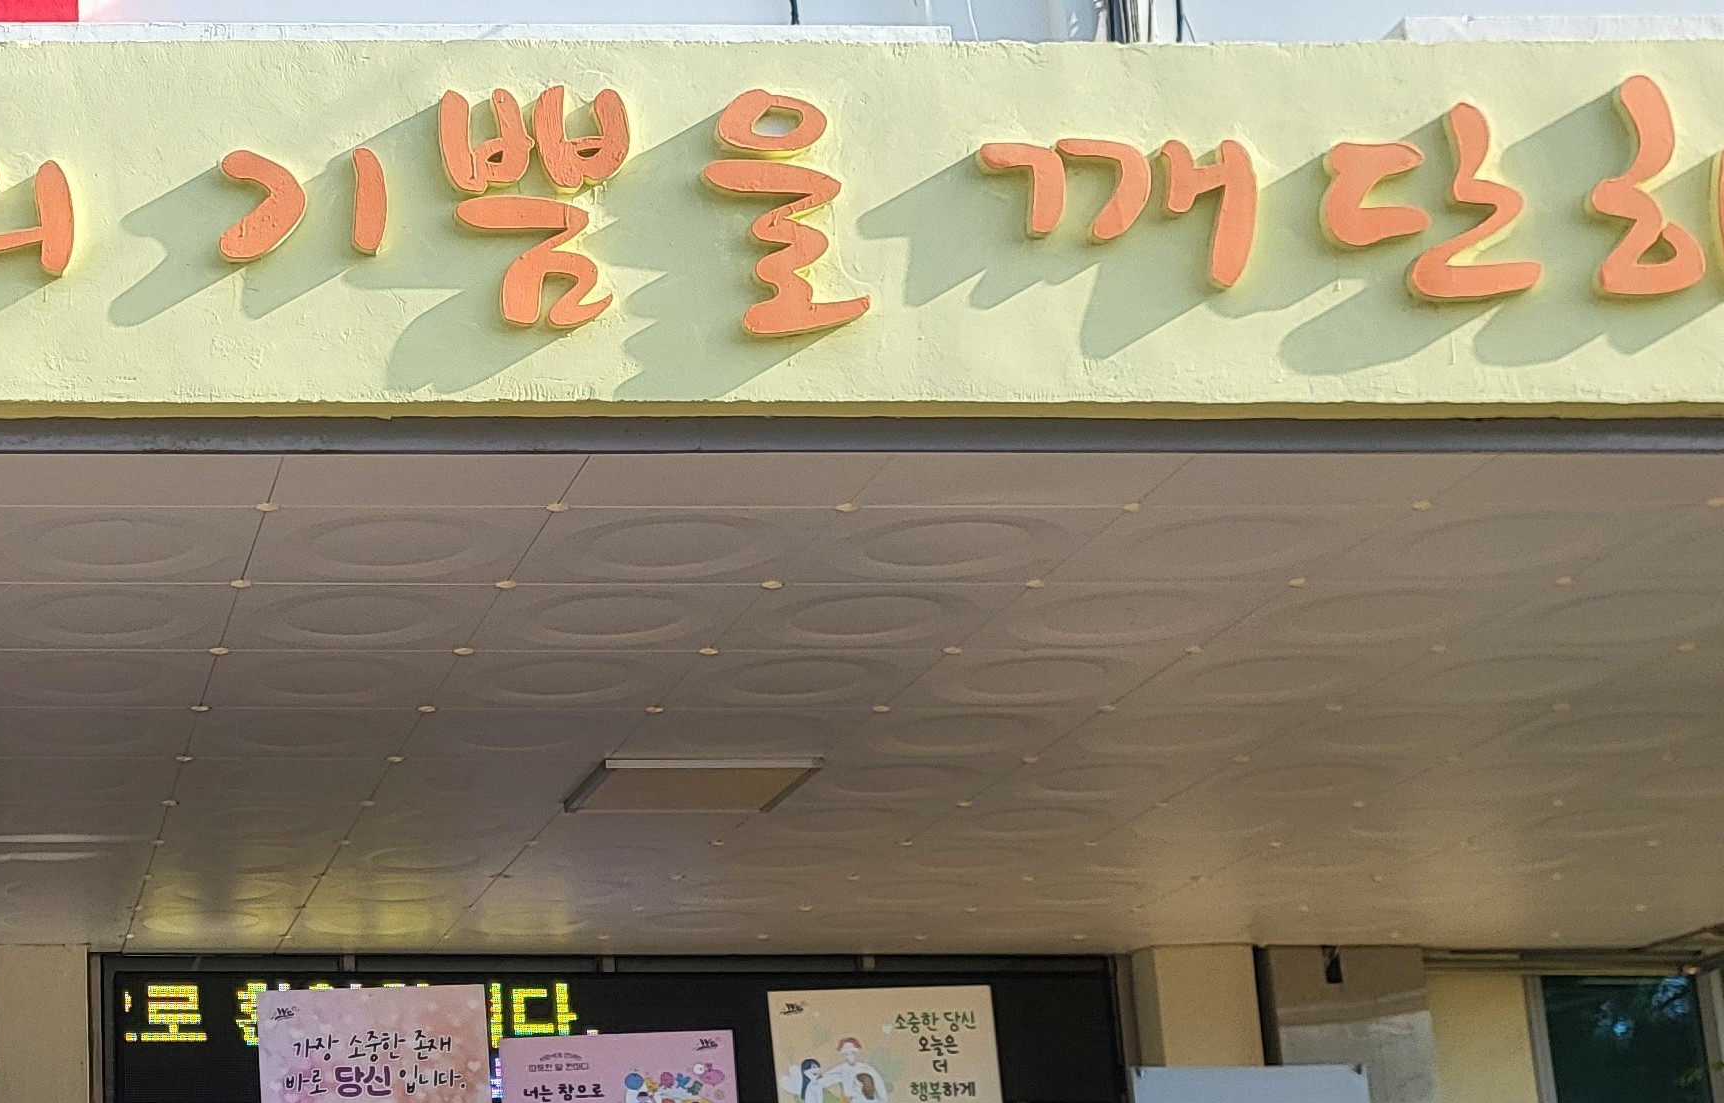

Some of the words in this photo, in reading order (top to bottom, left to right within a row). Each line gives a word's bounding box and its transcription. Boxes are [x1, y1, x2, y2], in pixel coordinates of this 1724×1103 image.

[221, 87, 868, 335] 기쁨을
[124, 984, 208, 1042] 로
[894, 1012, 939, 1032] 소중한
[943, 1011, 977, 1032] 당신
[293, 1034, 339, 1061] 가장
[348, 1031, 406, 1062] 소중한
[413, 1029, 452, 1060] 존재
[918, 1035, 959, 1056] 오늘은
[932, 1059, 948, 1074] 더
[286, 1069, 327, 1095] 바로
[334, 1065, 392, 1097] 당신
[399, 1065, 466, 1094] 입니다.
[909, 1081, 977, 1102] 행복하게
[523, 1084, 554, 1103] 너는
[558, 1083, 605, 1102] 참으로
